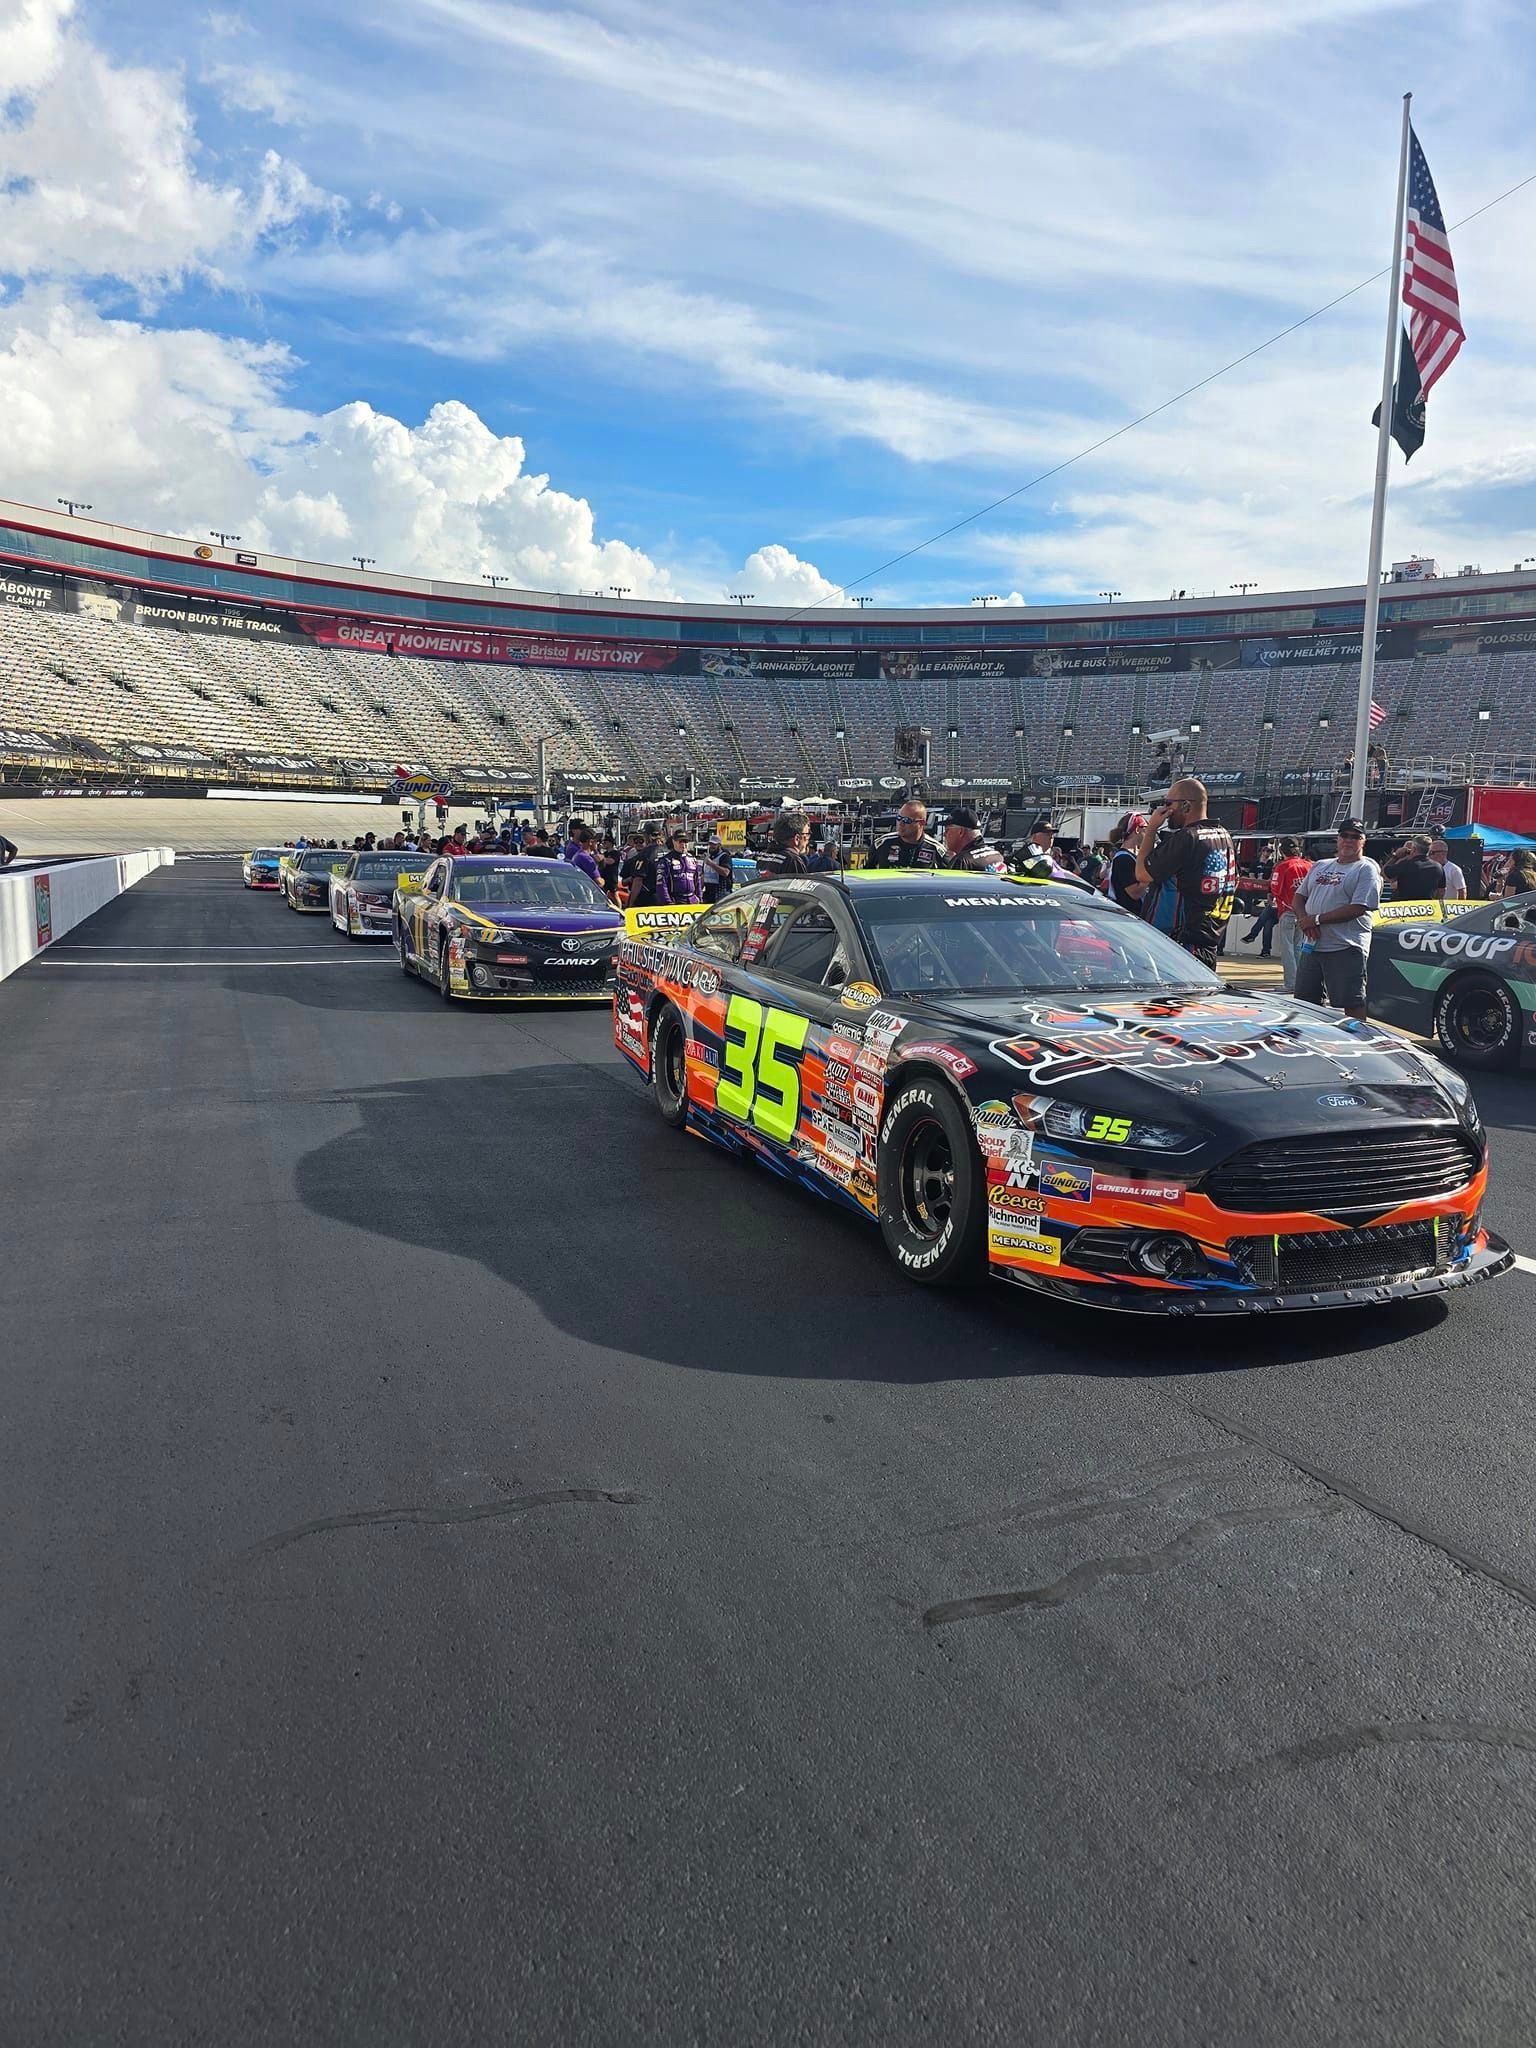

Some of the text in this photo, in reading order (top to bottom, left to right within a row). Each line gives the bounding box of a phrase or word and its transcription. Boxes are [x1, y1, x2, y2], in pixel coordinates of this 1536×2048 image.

[6, 594, 46, 608] CLASH #1
[136, 605, 281, 633] BRUTON BUYS THE TRACK
[224, 608, 241, 616] 1996
[337, 626, 644, 663] GREAT MOMENTS in Bristol HISTORY
[1476, 633, 1536, 645] COLOSSUS
[1263, 643, 1383, 660] TONY HELMET THRW
[750, 662, 855, 673] EARNHARDT/LABONTE
[907, 662, 1006, 671] DALE EARNHARDT Jr.
[1057, 659, 1081, 670] KYLE
[1121, 656, 1171, 666] WEEKEND
[563, 773, 592, 781] FOOD
[394, 782, 449, 793] SUNOCO
[945, 897, 1061, 907] MENARDS
[1379, 904, 1435, 918] MENARDS
[481, 928, 497, 942] 11
[1398, 928, 1517, 960] GROUP
[543, 957, 600, 966] CAMRY
[841, 986, 881, 1006] MENARDS
[868, 1012, 893, 1031] ARCA
[1439, 992, 1454, 1050] GENERAL
[1495, 988, 1513, 1047] GENERAL
[832, 1022, 862, 1040] COMETIC
[716, 994, 810, 1143] 35
[827, 1060, 849, 1080] KLOTZ
[1326, 1095, 1358, 1107] Ford
[852, 1105, 874, 1124] LINCOLN
[881, 1089, 934, 1144] GENERAL
[969, 1106, 1015, 1129] Bounty
[1085, 1114, 1133, 1144] 35
[978, 1133, 1006, 1147] Sioux
[833, 1143, 855, 1163] brembo
[1005, 1158, 1040, 1177] K&
[1042, 1174, 1089, 1191] SUNOCO
[1096, 1183, 1139, 1195] GENERAL
[1139, 1187, 1162, 1197] TIRE
[988, 1184, 1047, 1213] Reese's
[989, 1206, 1037, 1227] Richmond
[898, 1217, 954, 1269] GENERAL
[992, 1233, 1054, 1254] MENARDS
